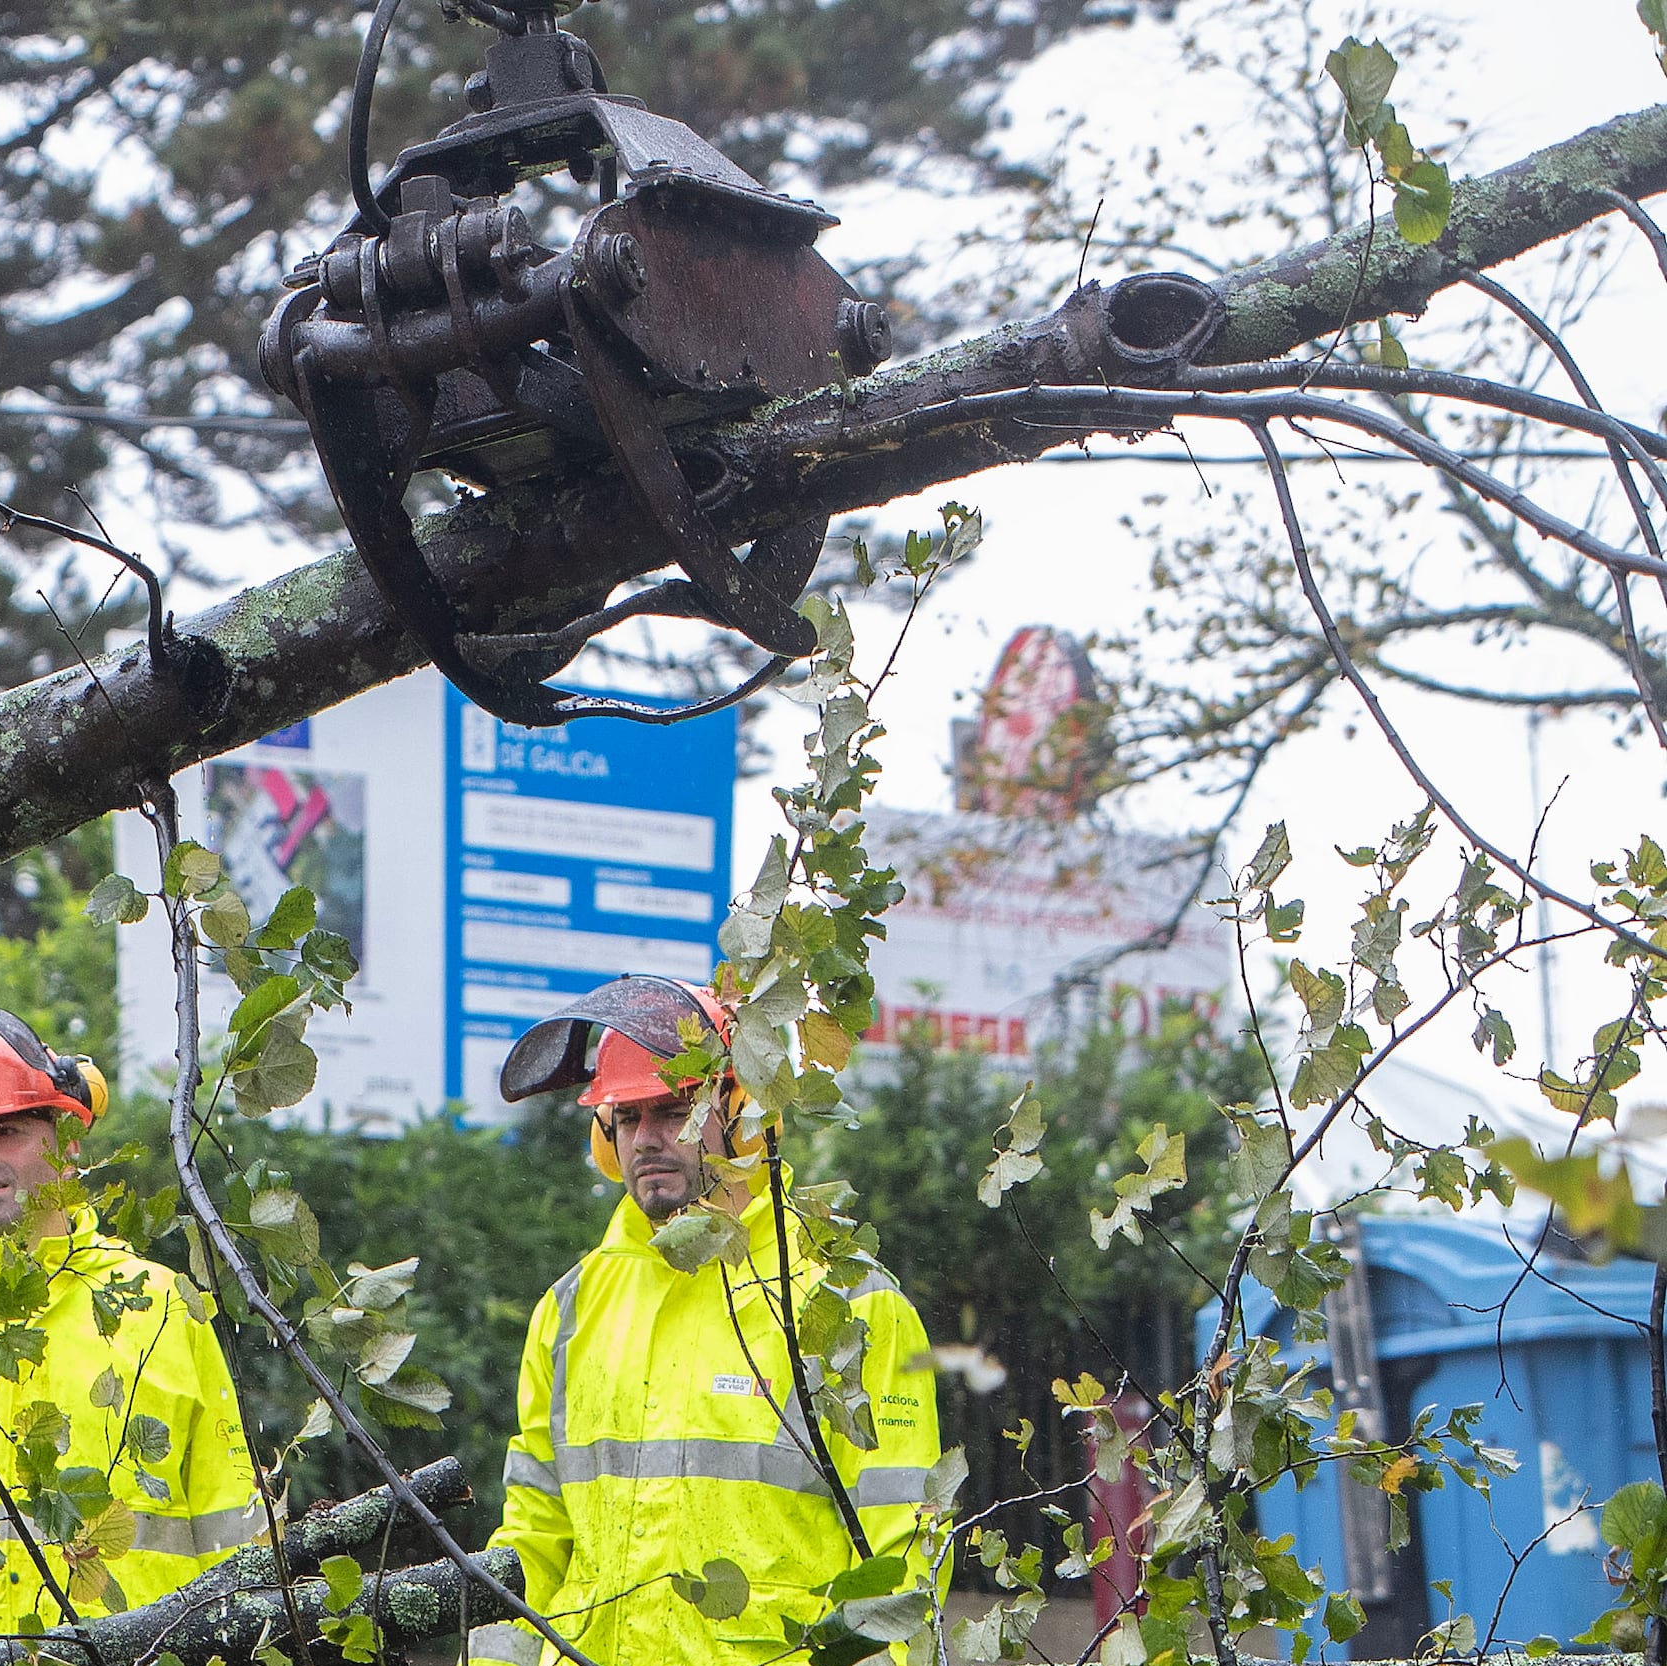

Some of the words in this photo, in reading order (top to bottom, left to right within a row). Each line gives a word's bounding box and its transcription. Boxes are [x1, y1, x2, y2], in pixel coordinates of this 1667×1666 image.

[500, 742, 524, 769] DE
[530, 745, 609, 777] GALICIA
[715, 1376, 750, 1385] CONCELLO
[880, 1393, 919, 1407] acciona
